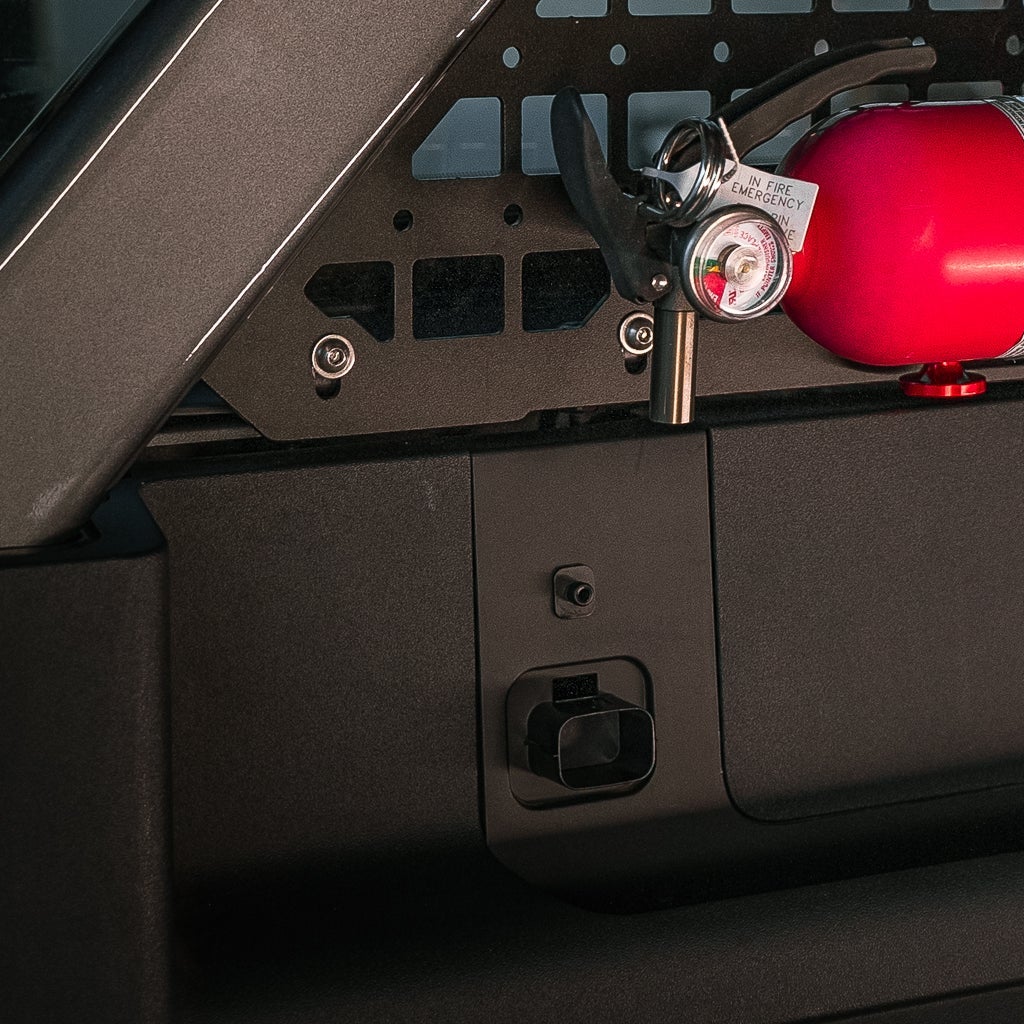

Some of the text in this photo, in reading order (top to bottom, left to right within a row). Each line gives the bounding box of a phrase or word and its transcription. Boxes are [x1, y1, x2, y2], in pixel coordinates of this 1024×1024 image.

[731, 182, 805, 211] EMERGENCY
[748, 174, 794, 196] IN FIRE
